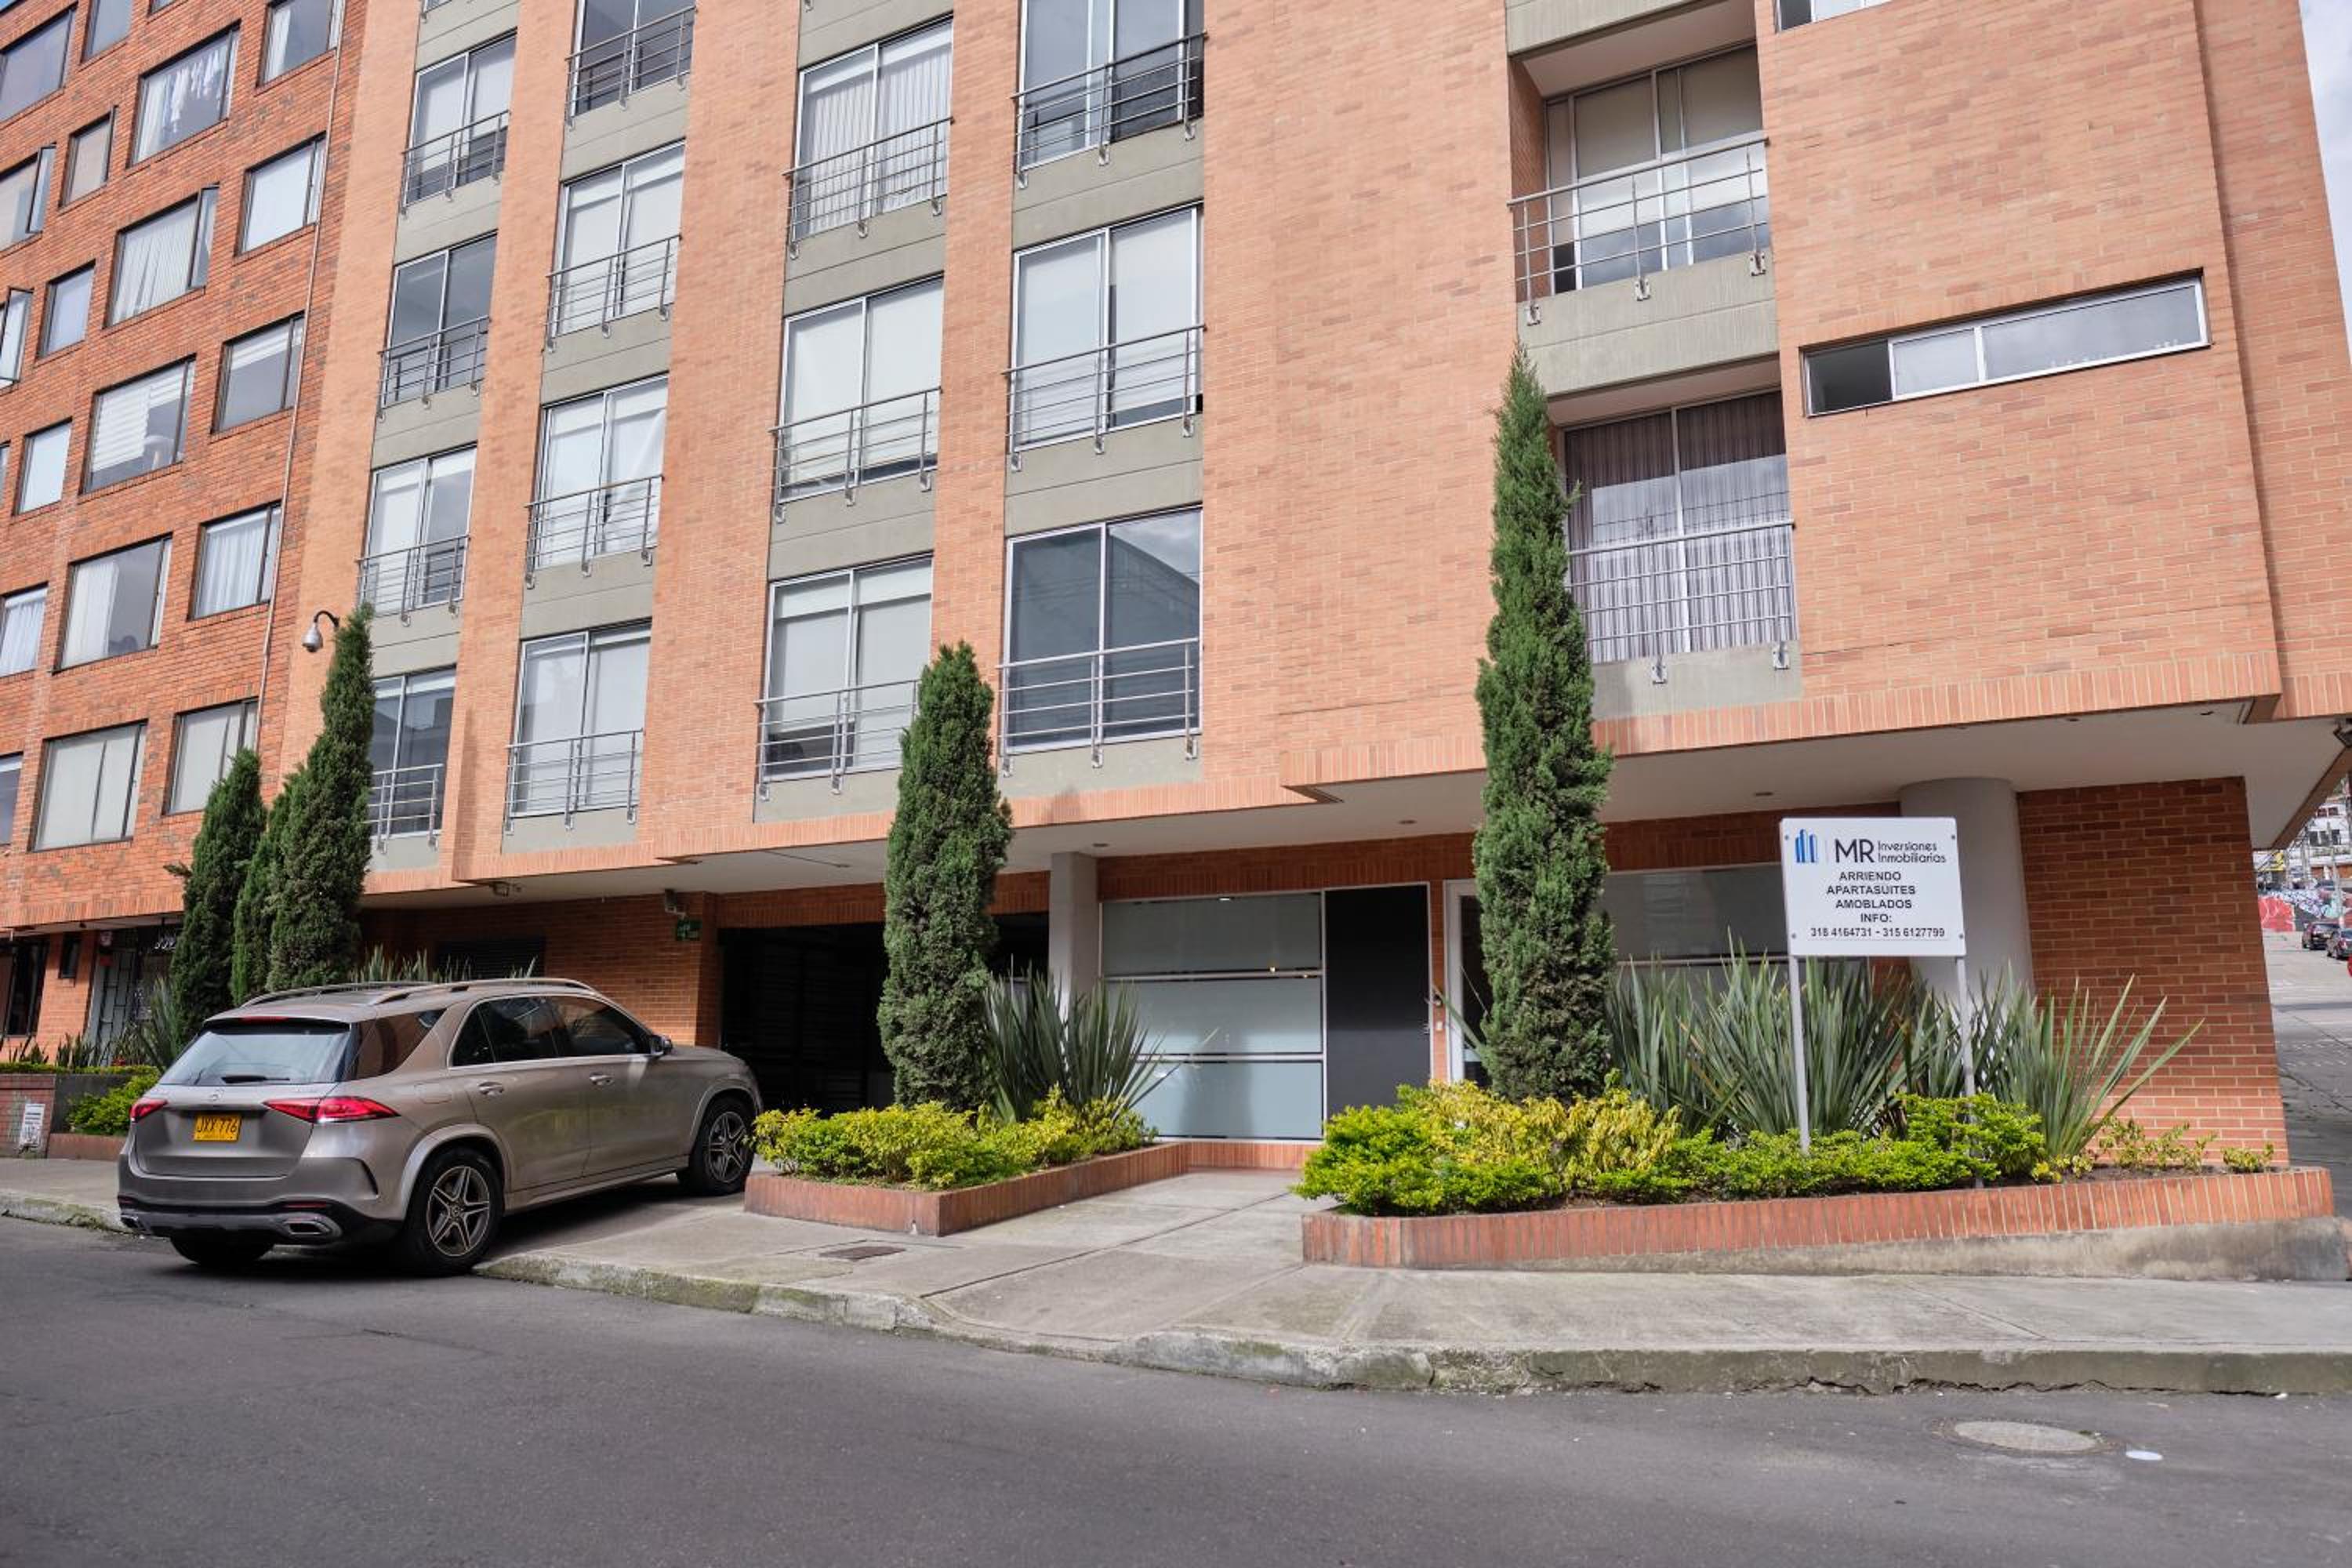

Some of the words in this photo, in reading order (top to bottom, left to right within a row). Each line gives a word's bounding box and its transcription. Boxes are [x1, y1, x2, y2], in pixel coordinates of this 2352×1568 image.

[1835, 838, 1875, 863] MR
[1878, 840, 1937, 851] Inversiones
[1878, 852, 1947, 863] Inmobiliarias
[1839, 871, 1902, 881] ARRIENDO
[1826, 885, 1916, 895] APARTASUITES
[1835, 899, 1912, 909] AMOBLADOS
[1860, 913, 1893, 923] INFO:
[1882, 927, 1901, 937] 315
[1903, 927, 1945, 937] 6127799
